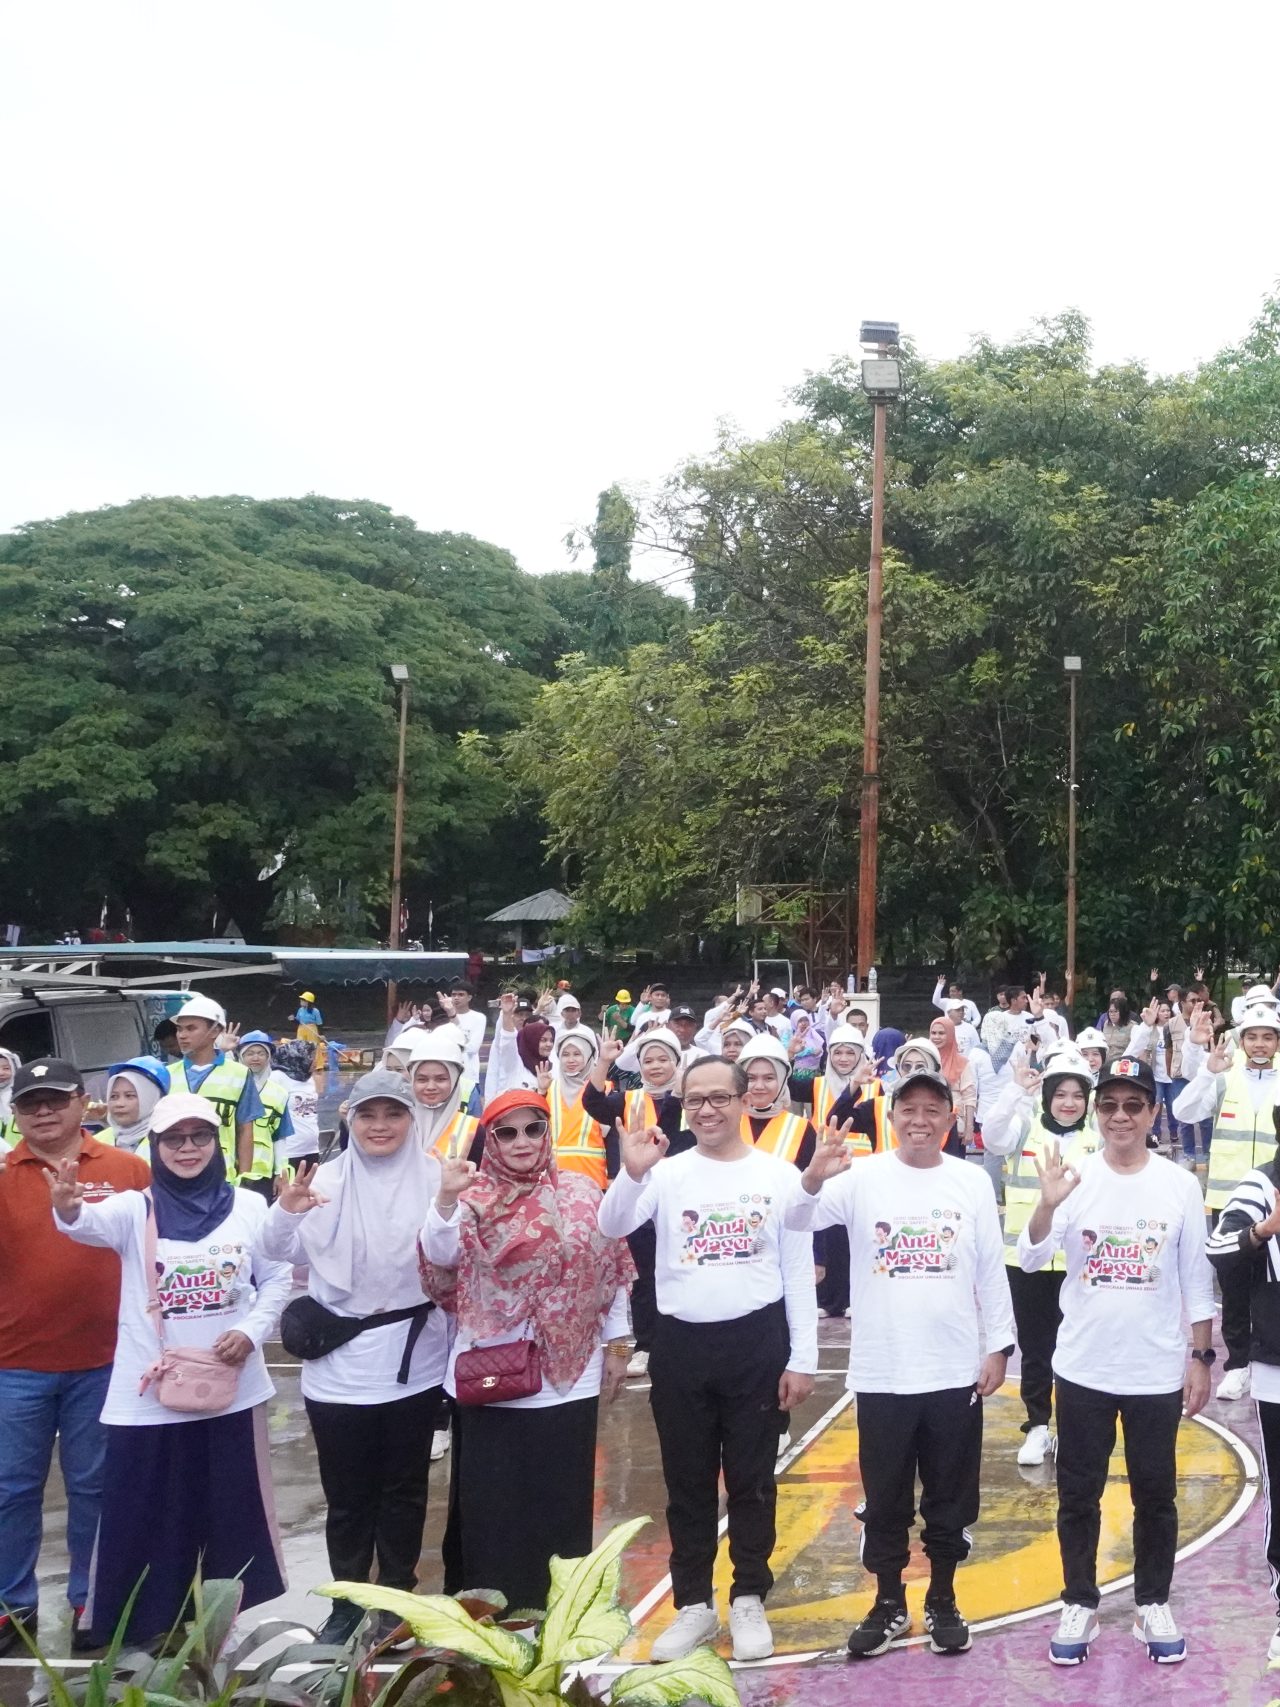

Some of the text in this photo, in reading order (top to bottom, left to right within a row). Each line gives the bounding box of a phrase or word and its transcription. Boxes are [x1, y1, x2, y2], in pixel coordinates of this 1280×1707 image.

[706, 1219, 745, 1237] Anti
[694, 1238, 752, 1257] Mager
[897, 1233, 936, 1249] Anti
[1100, 1243, 1140, 1259] Anti
[886, 1251, 945, 1271] Mager
[1089, 1260, 1148, 1281] Mager
[171, 1270, 216, 1290] Anti
[159, 1289, 226, 1310] Mager
